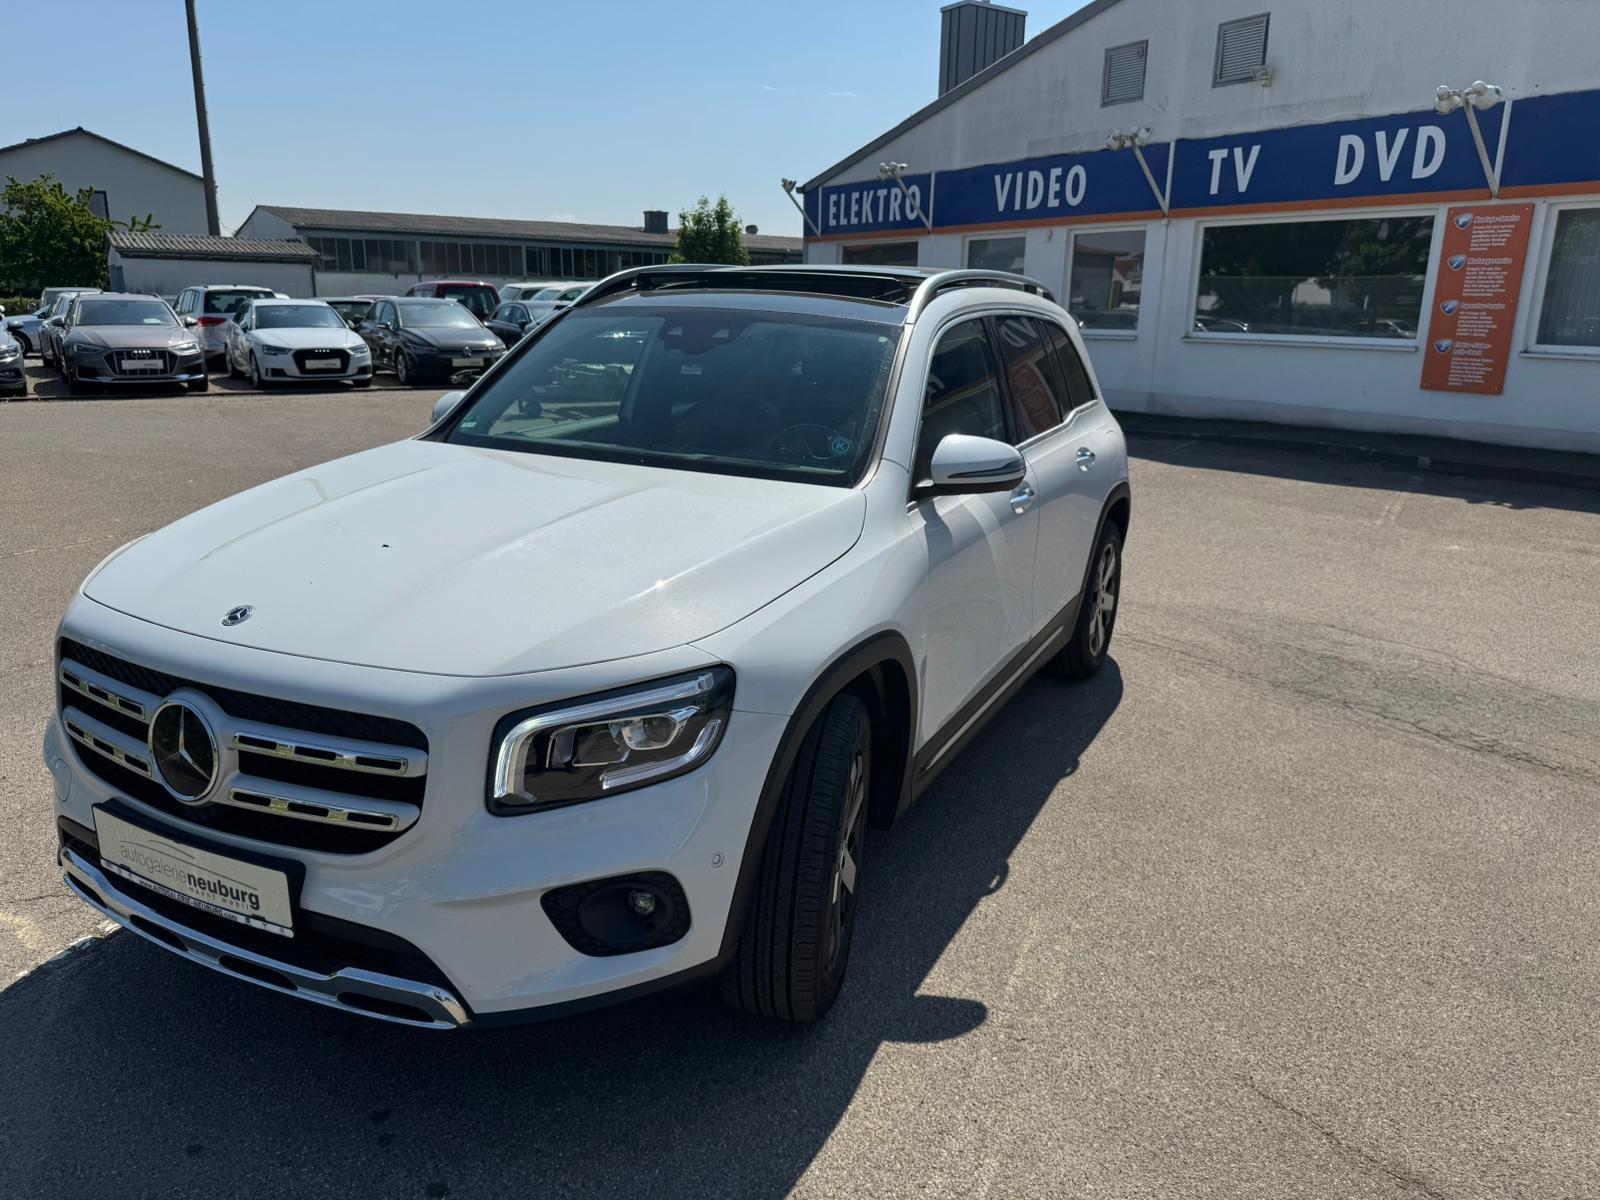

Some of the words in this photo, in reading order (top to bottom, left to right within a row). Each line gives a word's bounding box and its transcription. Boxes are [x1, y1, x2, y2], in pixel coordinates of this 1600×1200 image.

[828, 184, 921, 227] ELEKTRO
[994, 164, 1087, 212] VIDEO
[1208, 144, 1261, 195] TV
[1334, 125, 1446, 185] DVD
